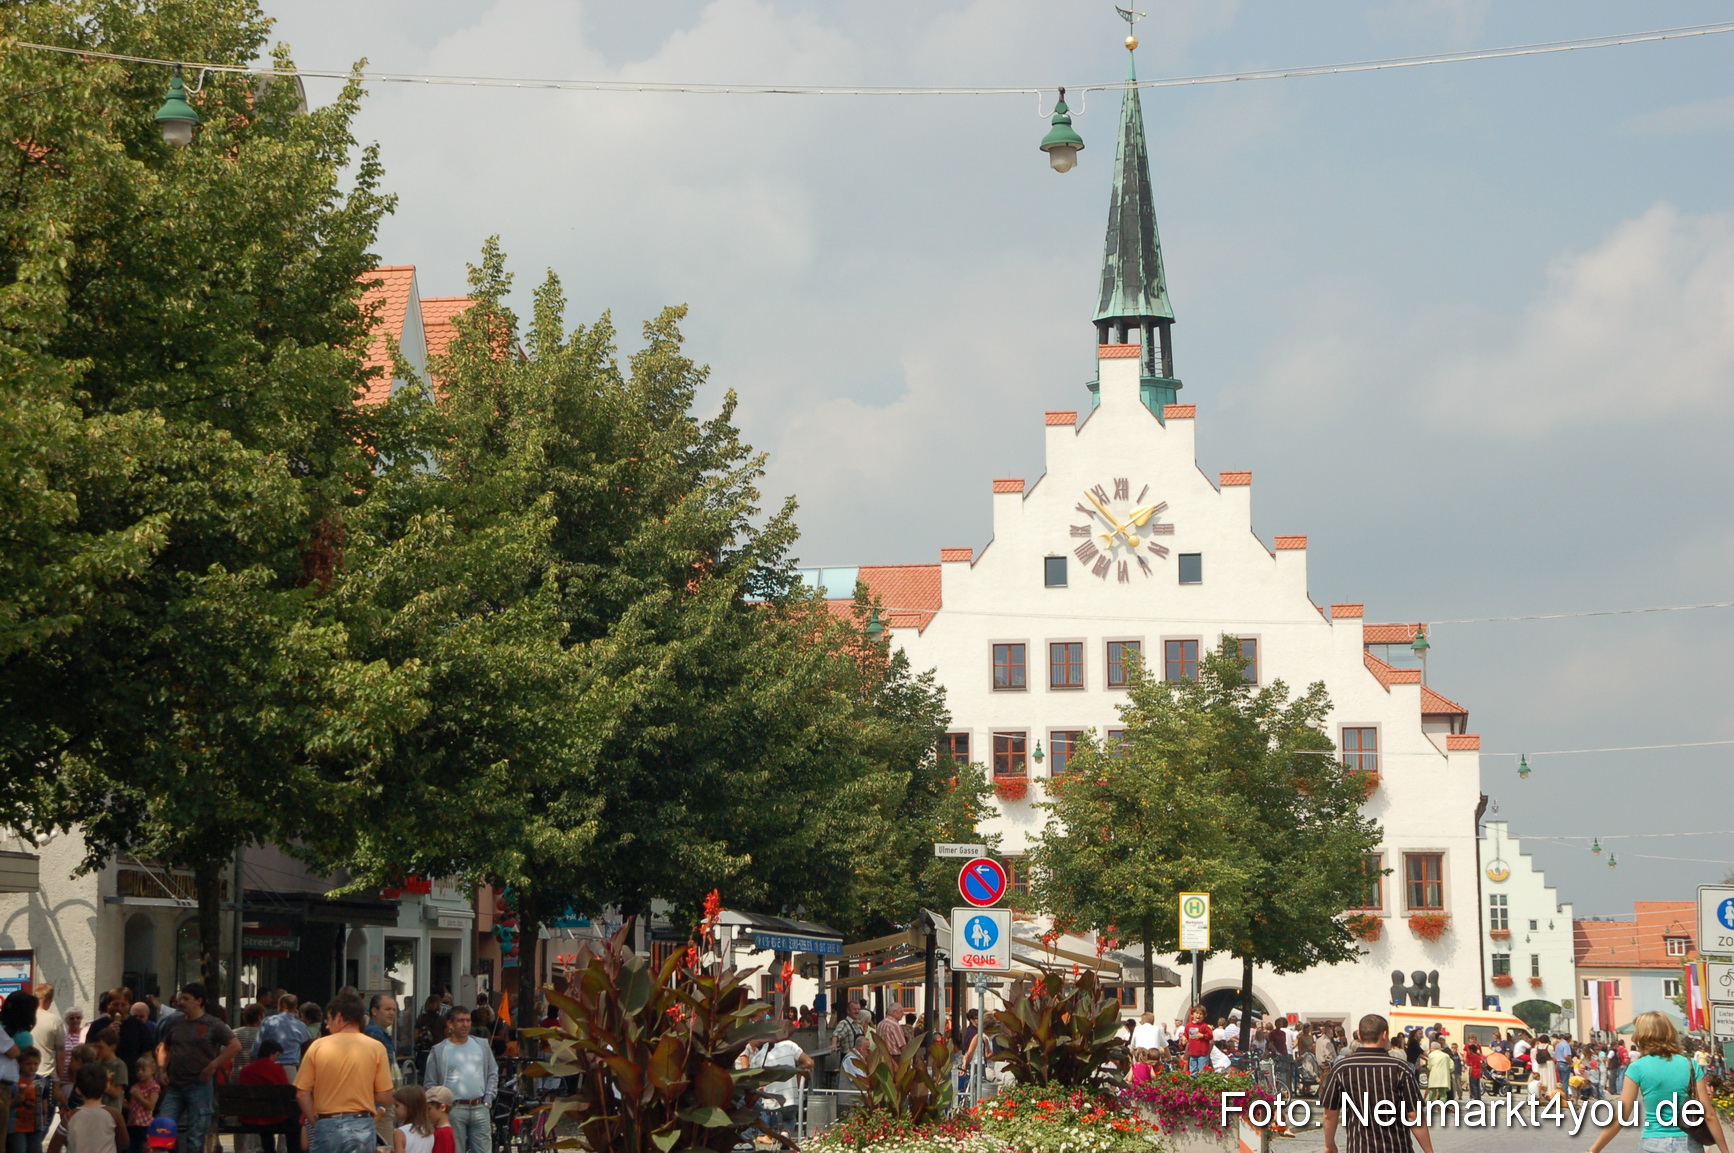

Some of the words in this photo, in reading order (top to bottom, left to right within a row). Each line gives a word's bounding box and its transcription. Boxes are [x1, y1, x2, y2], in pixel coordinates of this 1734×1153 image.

[1090, 483, 1111, 506] XI
[1113, 477, 1129, 501] XII
[1075, 502, 1097, 520] X
[1069, 524, 1092, 537] IX
[1152, 523, 1175, 536] III
[1073, 539, 1099, 566] VIII
[1091, 554, 1112, 580] VII
[1137, 555, 1153, 578] V
[938, 846, 957, 854] Ulmer
[959, 846, 979, 855] Gasse
[243, 936, 272, 946] Street
[272, 938, 295, 948] One
[966, 954, 996, 965] ZONE
